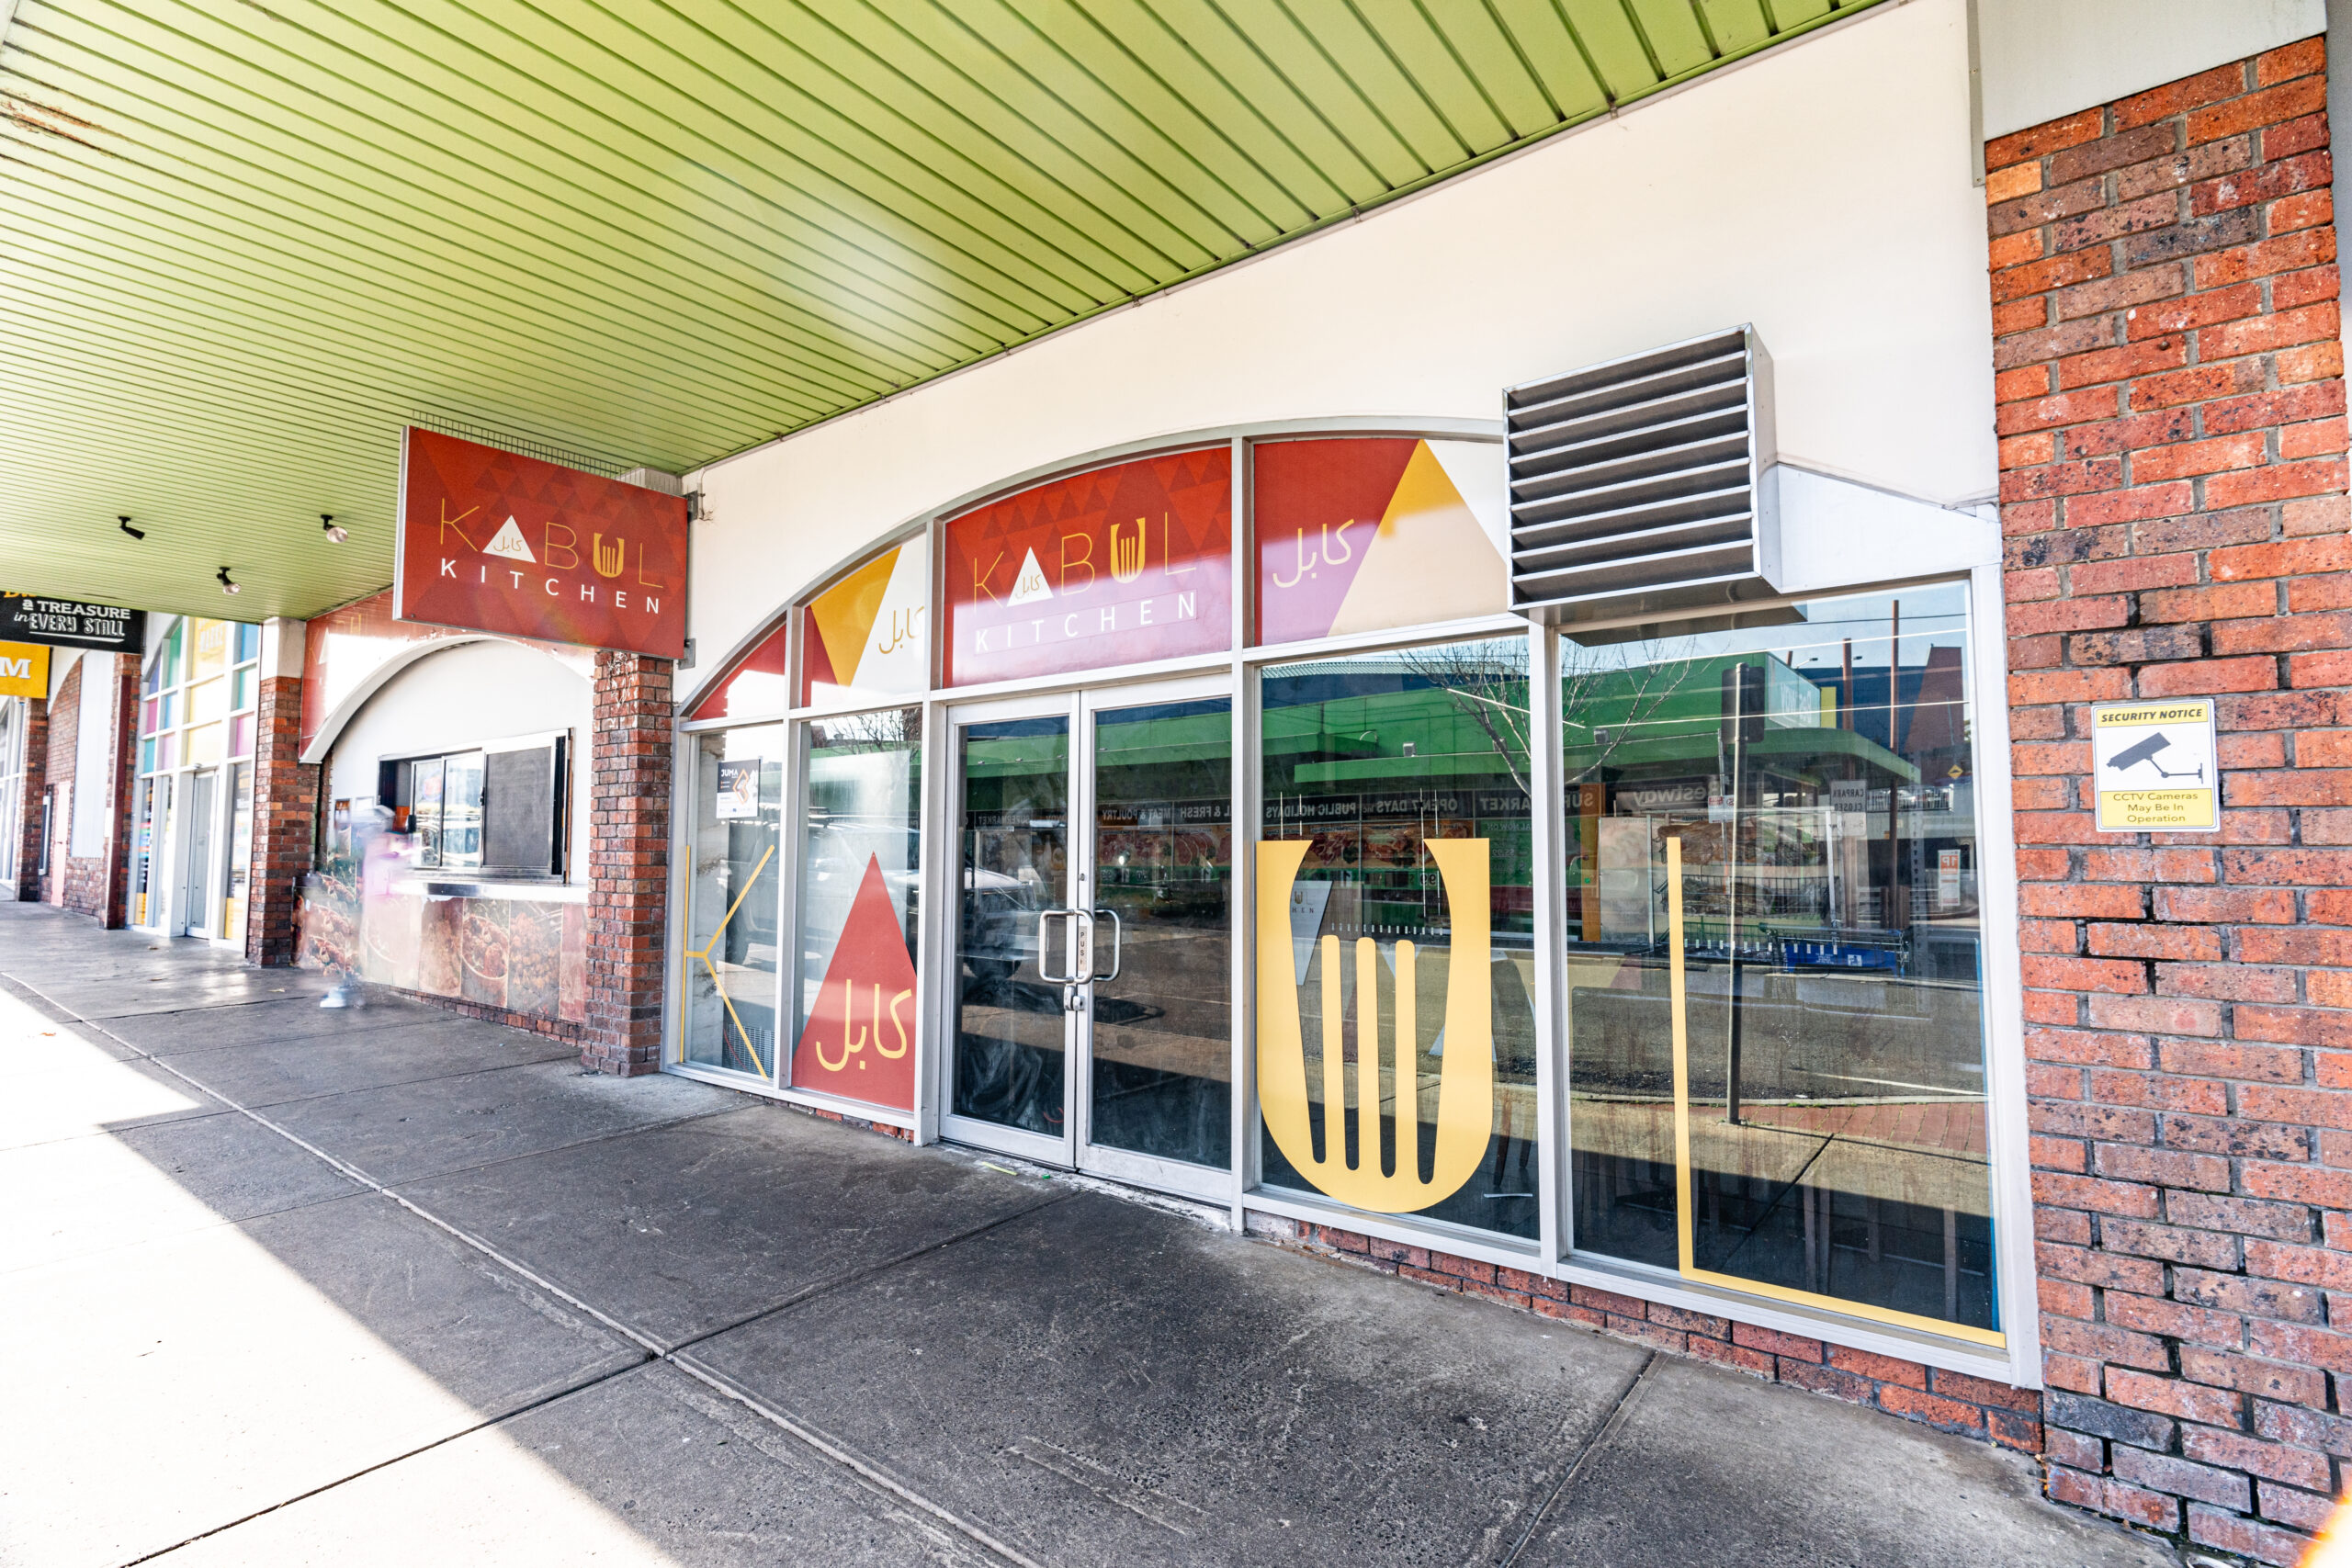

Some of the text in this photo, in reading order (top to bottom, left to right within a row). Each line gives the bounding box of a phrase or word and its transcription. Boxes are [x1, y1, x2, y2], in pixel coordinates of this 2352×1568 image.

[1272, 518, 1355, 588] كابل
[441, 558, 660, 615] KITCHEN
[37, 600, 131, 620] TREASURE
[28, 613, 77, 633] EVERY
[83, 617, 126, 637] STALL
[975, 592, 1196, 653] KITCHEN
[2101, 708, 2202, 723] SECURITY NOTICE
[2113, 792, 2199, 801] CCTV Cameras
[2127, 804, 2151, 814] May
[2173, 803, 2184, 811] In
[2127, 815, 2186, 824] Operation
[815, 978, 912, 1071] كابل
